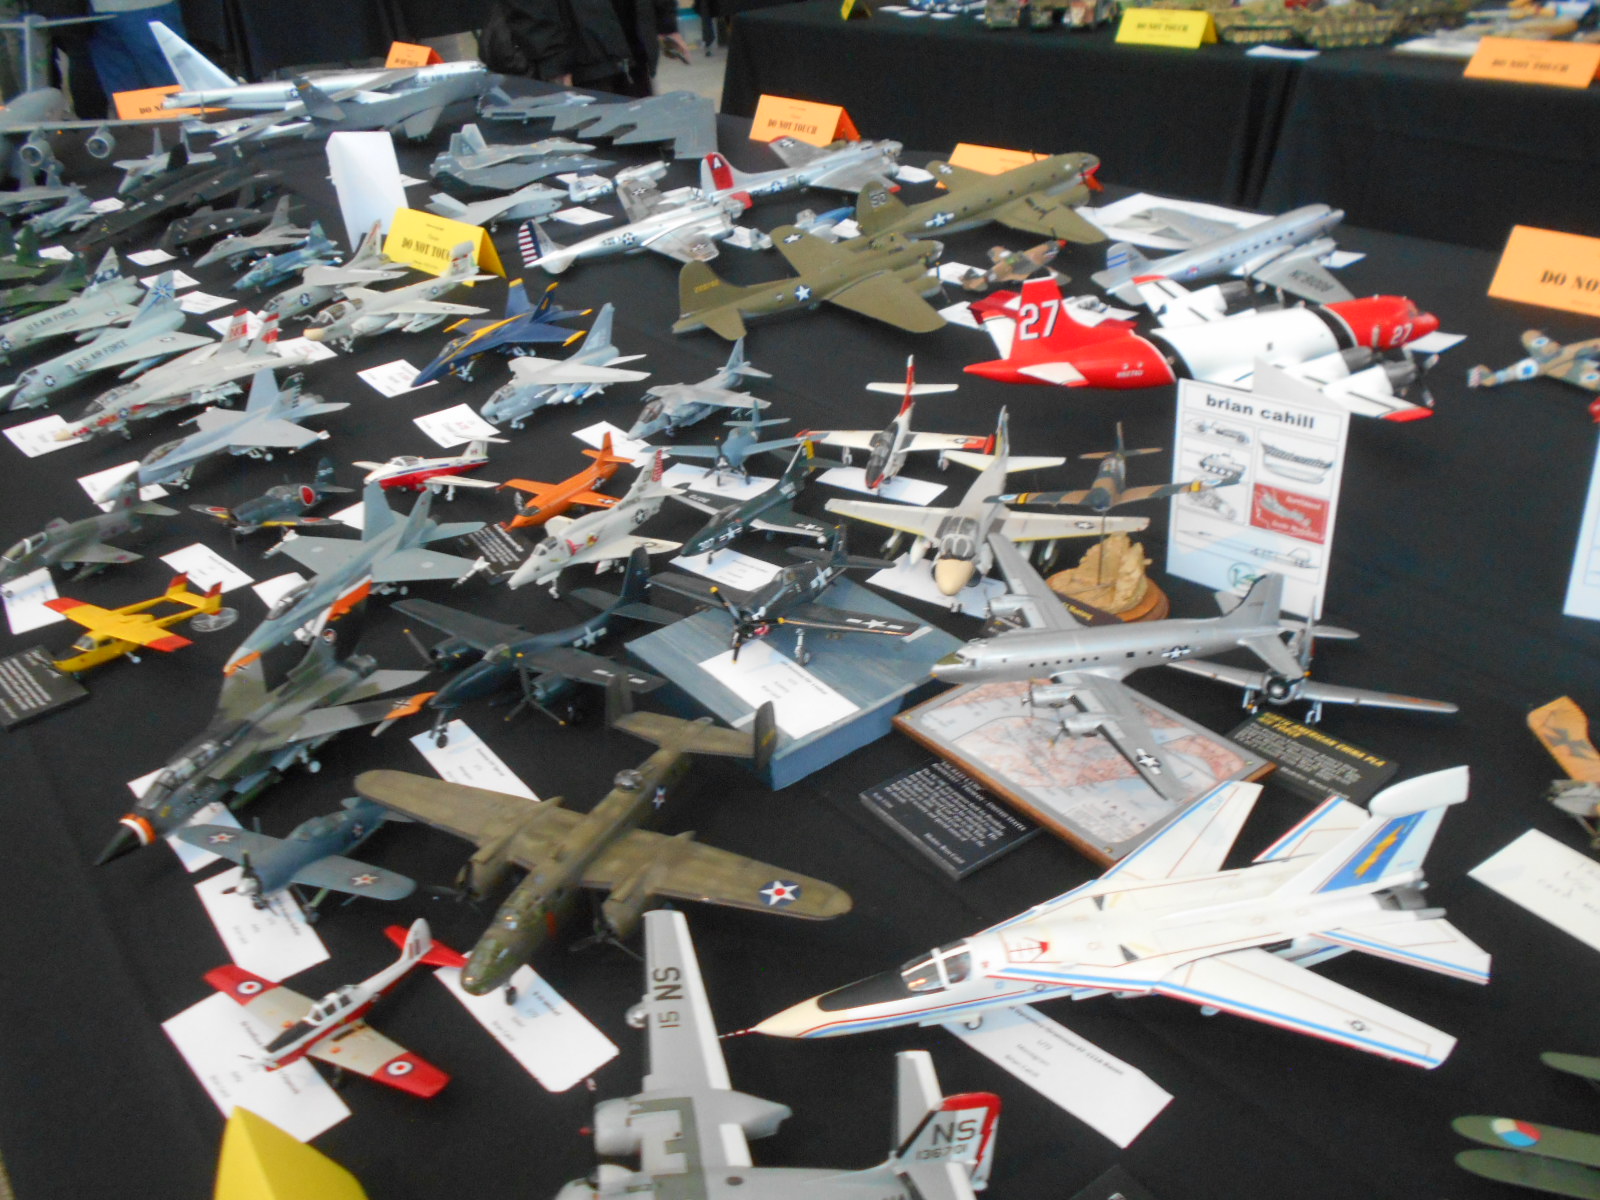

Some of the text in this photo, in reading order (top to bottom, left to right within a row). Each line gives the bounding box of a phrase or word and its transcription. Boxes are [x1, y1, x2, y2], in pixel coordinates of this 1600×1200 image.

[767, 118, 819, 135] DO NOT TOUCH
[713, 156, 722, 168] A
[401, 237, 451, 262] DO NOT TOUC
[1540, 270, 1600, 292] DO NO
[1018, 299, 1060, 341] 27
[1389, 322, 1414, 345] 27
[1205, 394, 1316, 430] brian cahill
[653, 967, 685, 1001] NS
[657, 1011, 682, 1029] 15
[932, 1119, 978, 1146] NS
